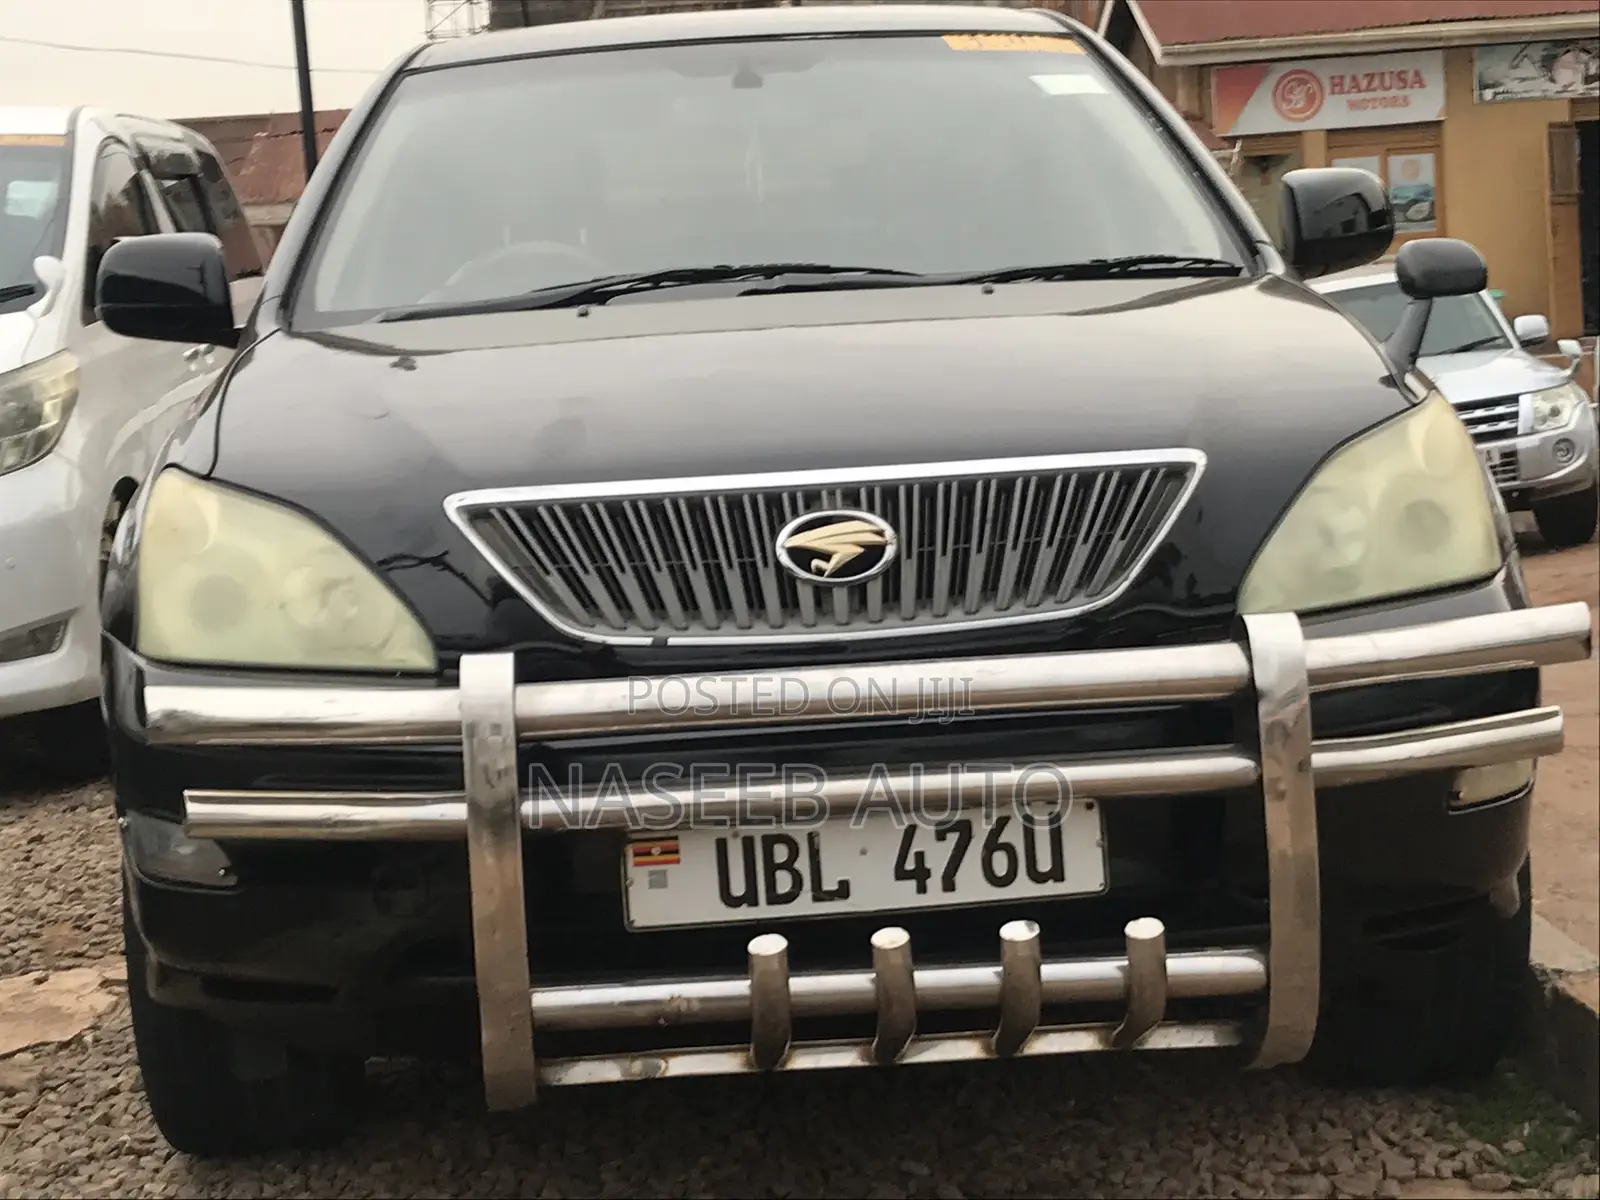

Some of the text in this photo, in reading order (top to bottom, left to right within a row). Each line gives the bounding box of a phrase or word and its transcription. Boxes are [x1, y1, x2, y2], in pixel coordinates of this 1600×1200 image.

[1328, 69, 1426, 95] HAZUSA
[715, 812, 1066, 909] UBL 476U
